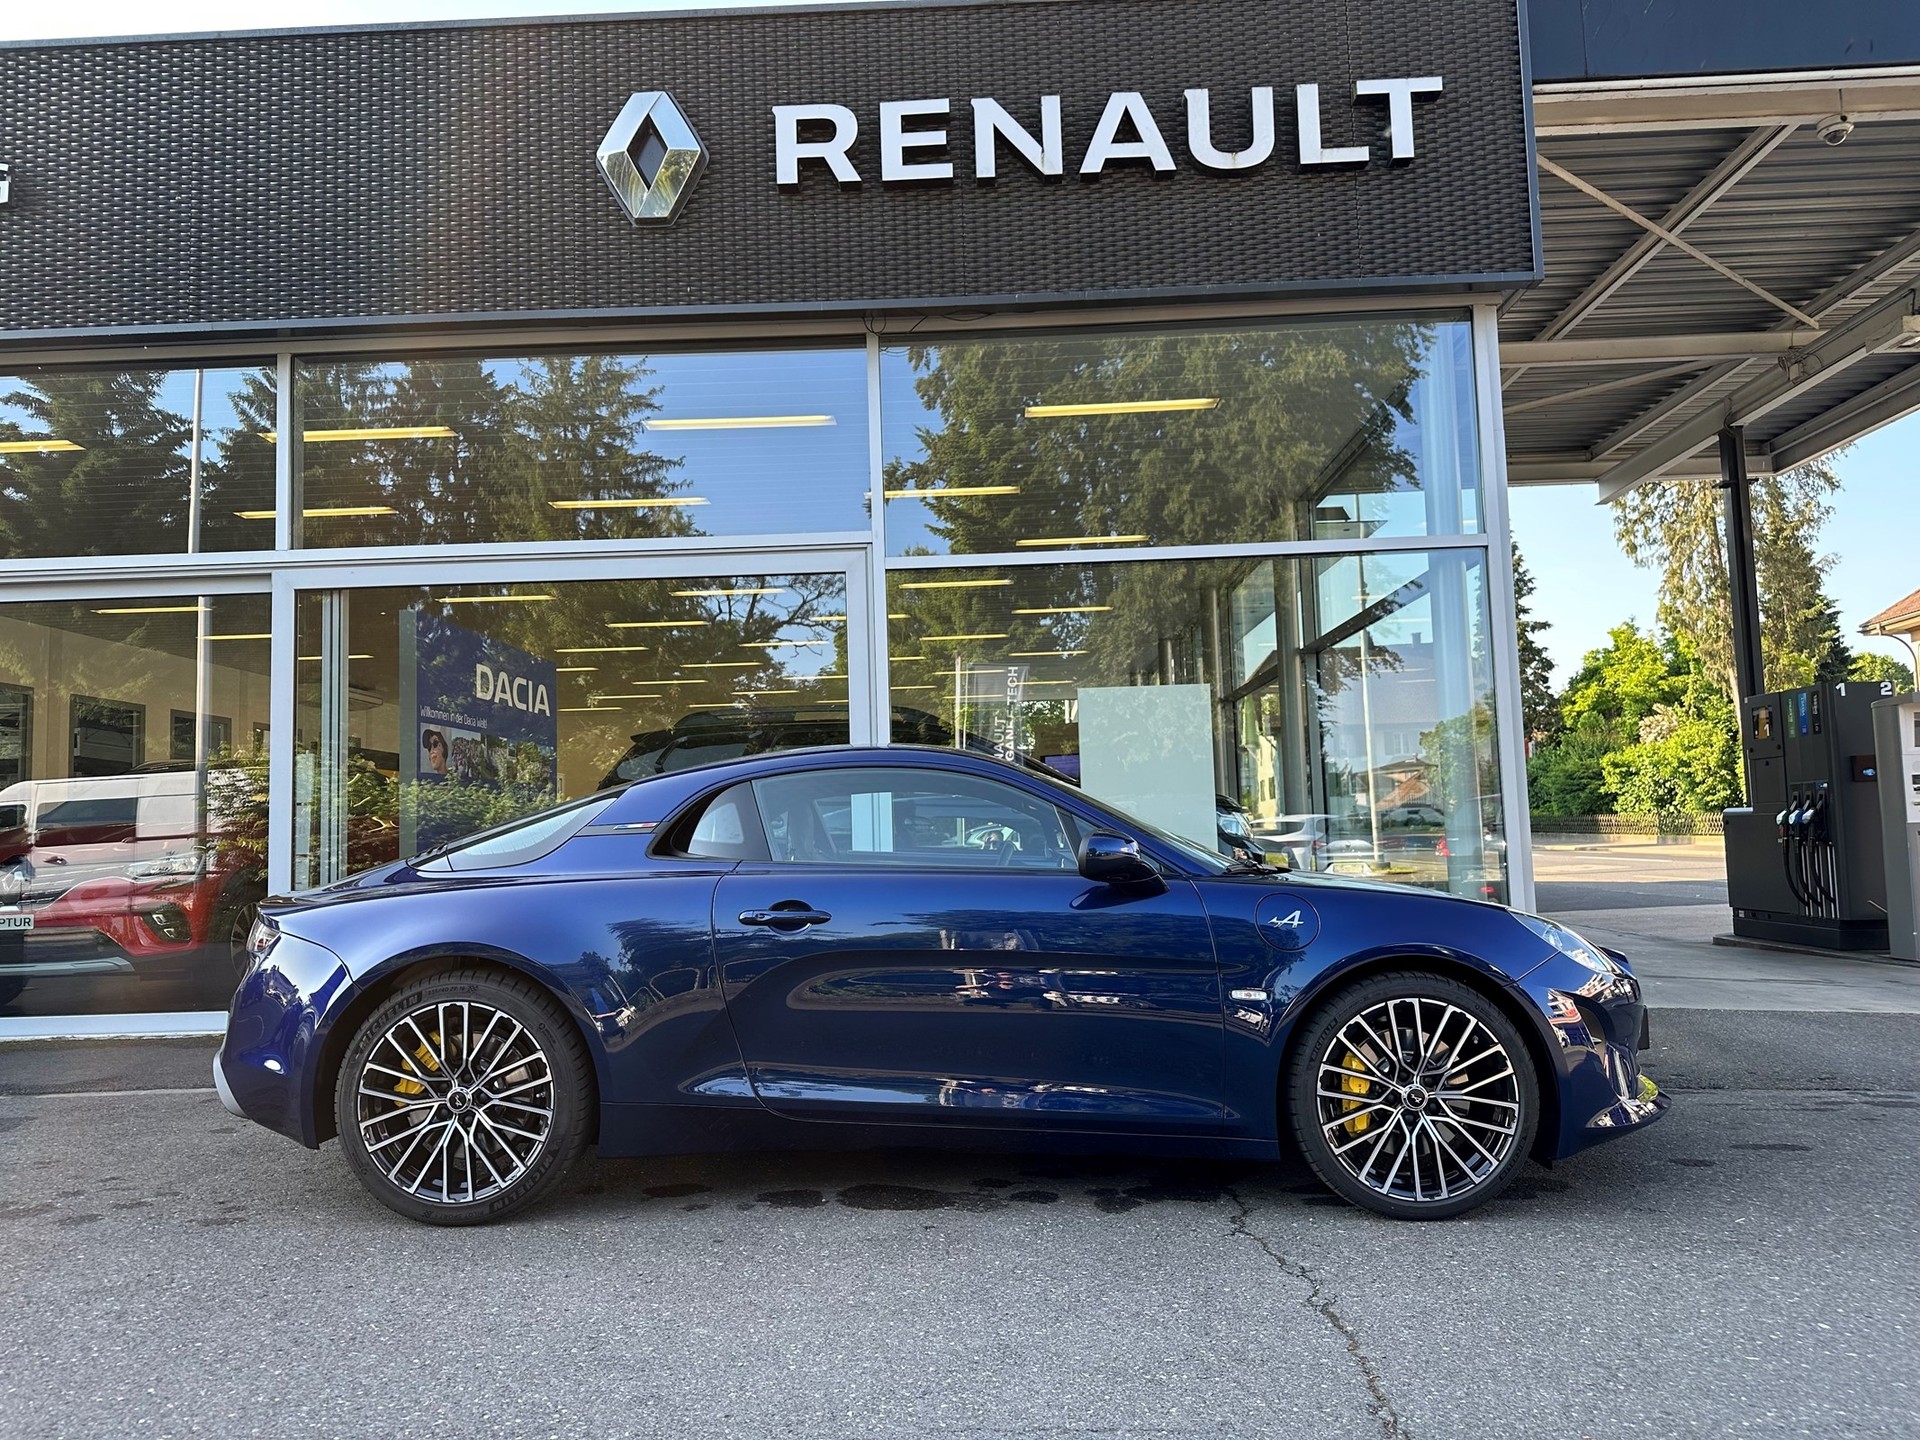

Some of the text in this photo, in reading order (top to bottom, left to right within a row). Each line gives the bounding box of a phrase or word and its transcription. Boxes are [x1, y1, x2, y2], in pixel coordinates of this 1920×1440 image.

[772, 77, 1443, 188] RENAULT
[475, 663, 550, 716] DACIA
[1835, 682, 1846, 697] 1
[1880, 681, 1892, 696] 2
[464, 714, 476, 727] Dacia
